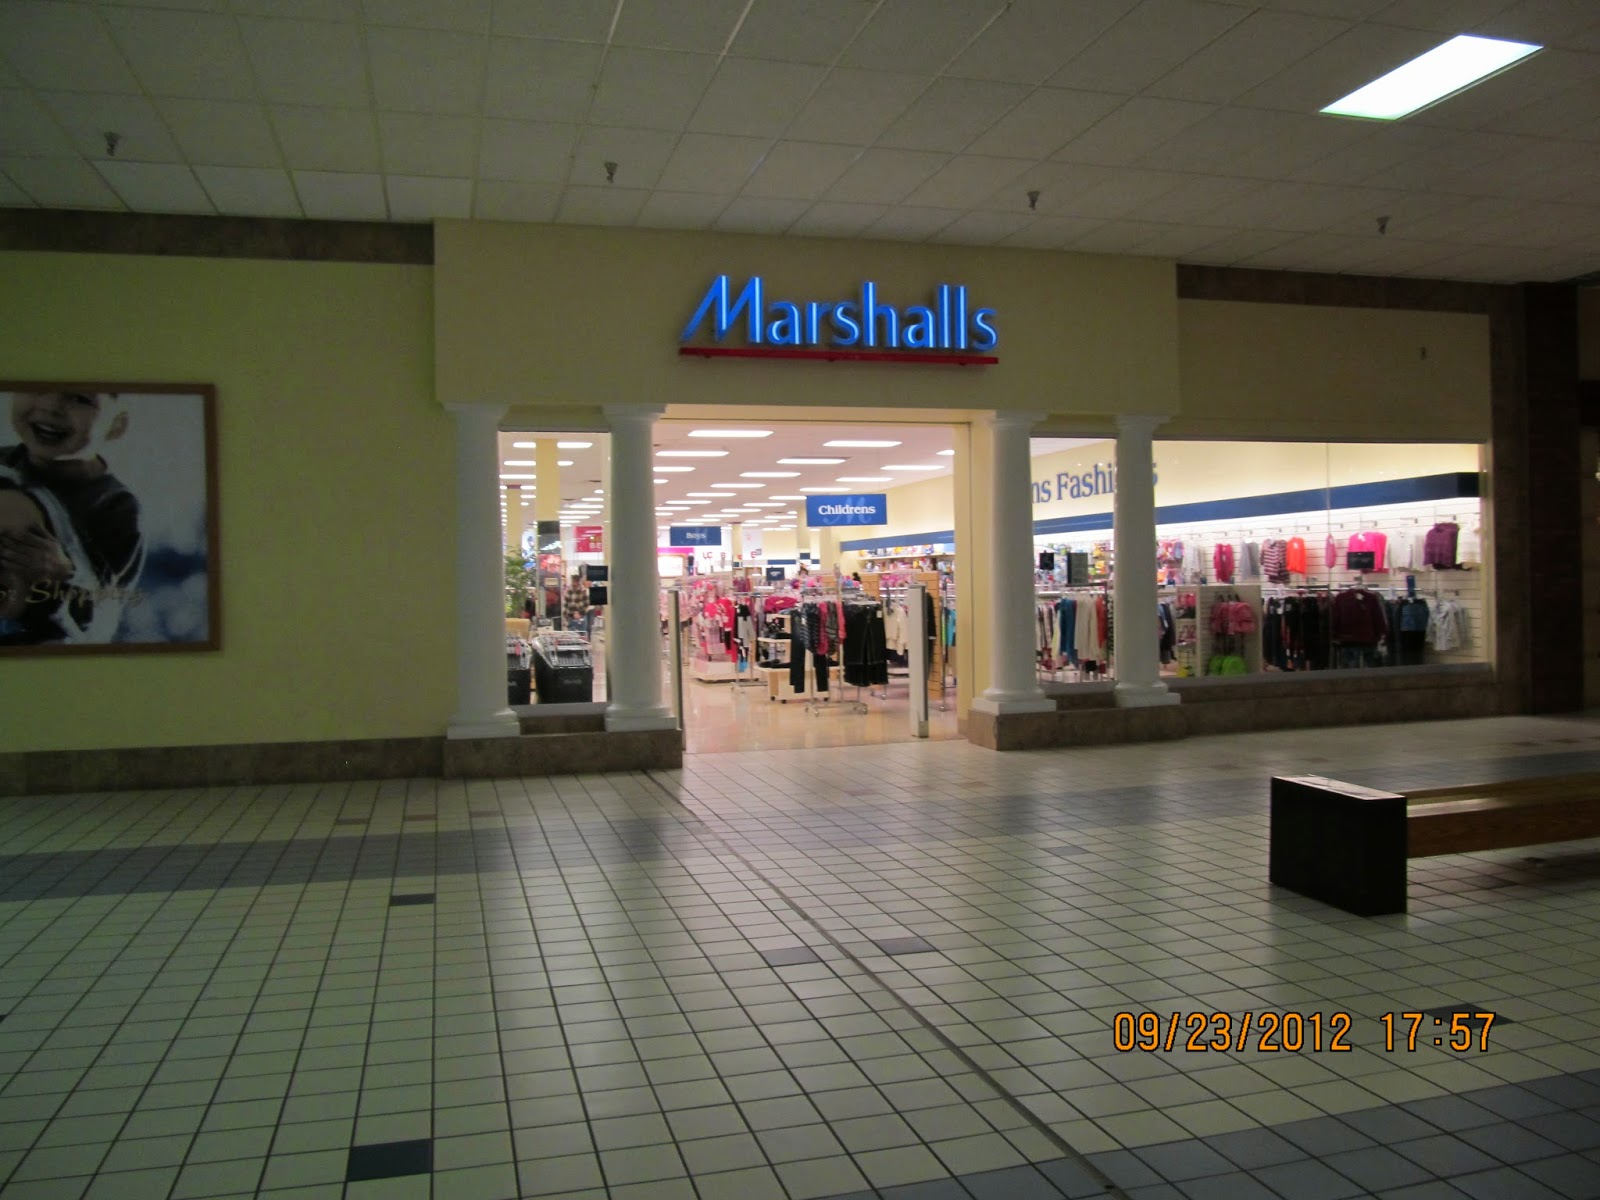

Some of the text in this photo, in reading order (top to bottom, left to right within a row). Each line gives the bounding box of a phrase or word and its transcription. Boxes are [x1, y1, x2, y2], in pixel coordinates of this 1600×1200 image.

[680, 274, 999, 352] Marshalls
[818, 504, 876, 515] Childrens
[685, 532, 707, 540] Boys
